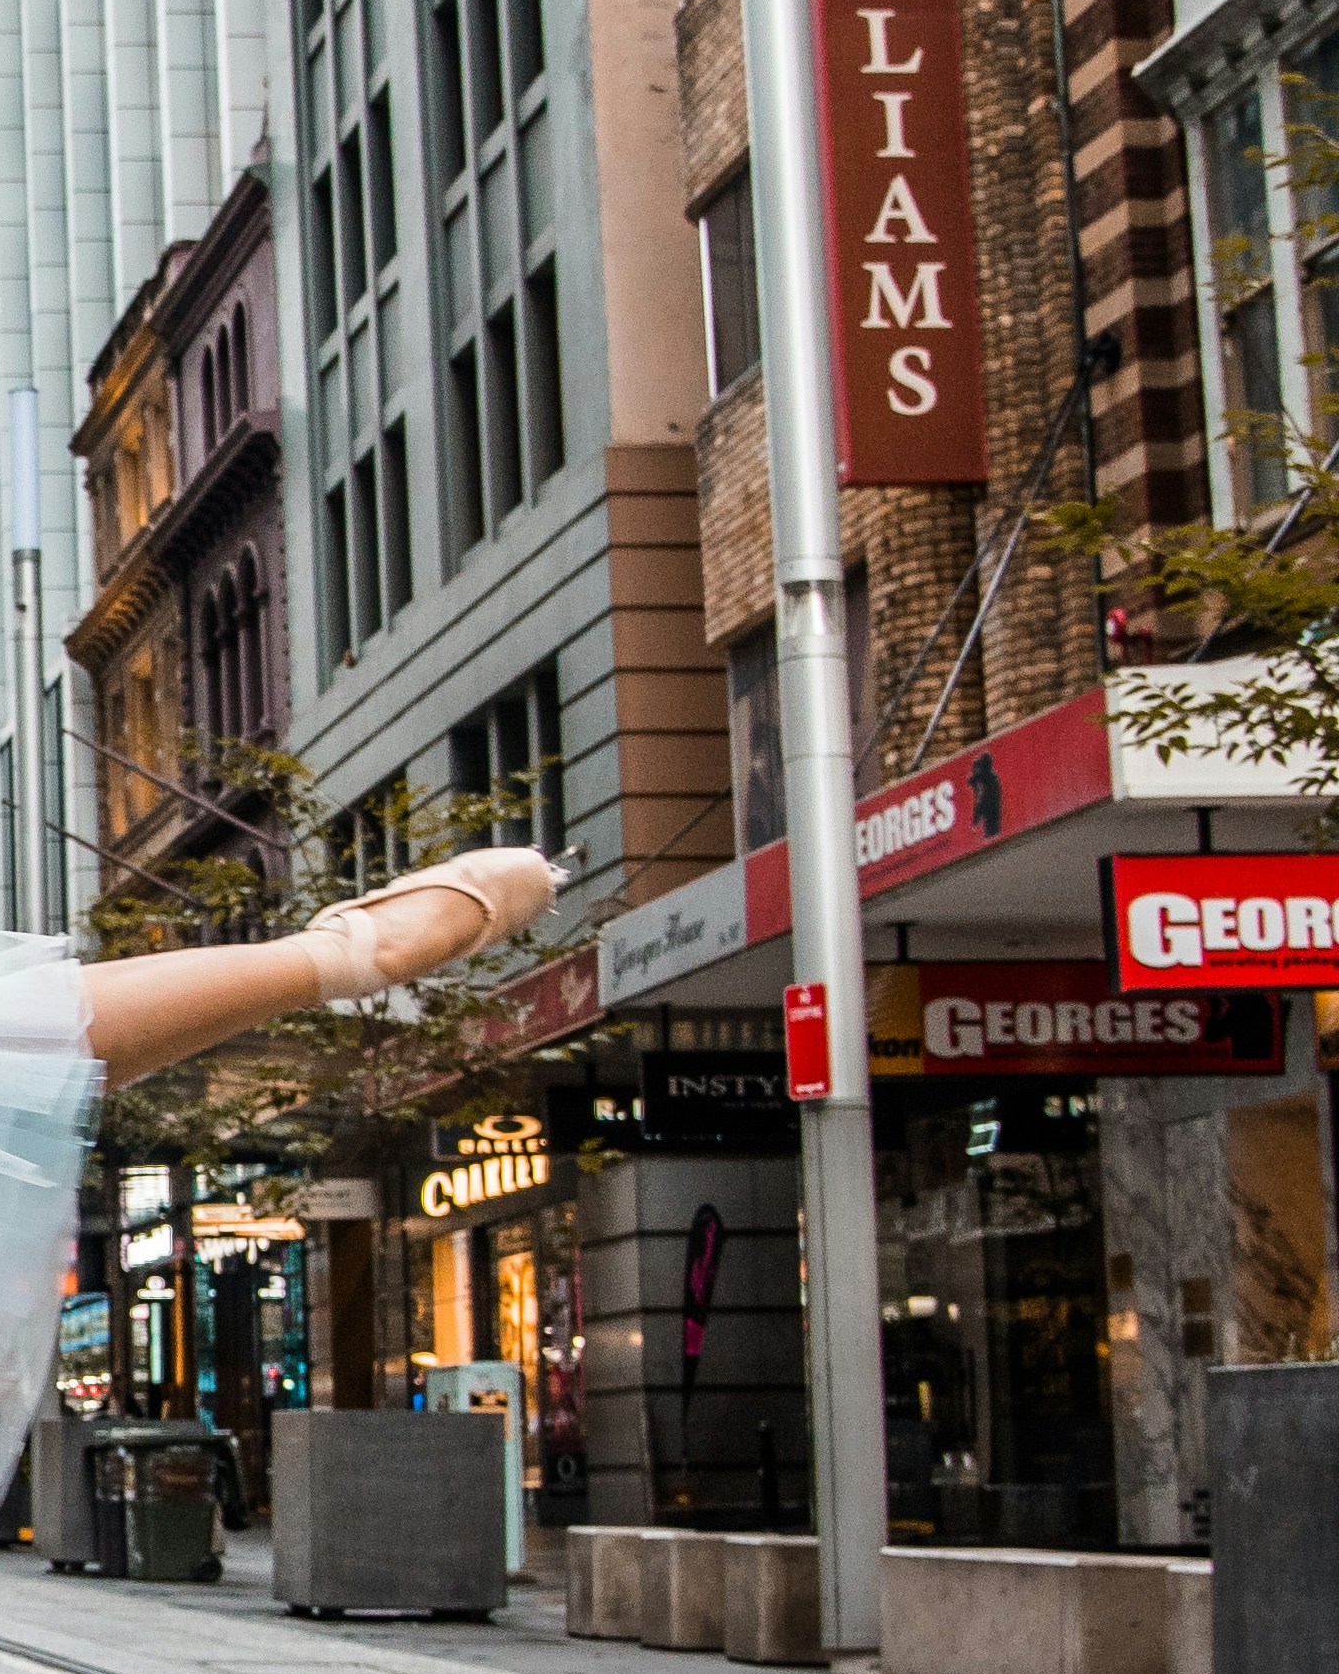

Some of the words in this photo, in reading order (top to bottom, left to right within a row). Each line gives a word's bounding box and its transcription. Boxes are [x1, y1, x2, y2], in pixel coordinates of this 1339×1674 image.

[856, 780, 955, 868] EORGES
[1127, 891, 1339, 969] GEOR
[924, 997, 1200, 1059] GEORGES
